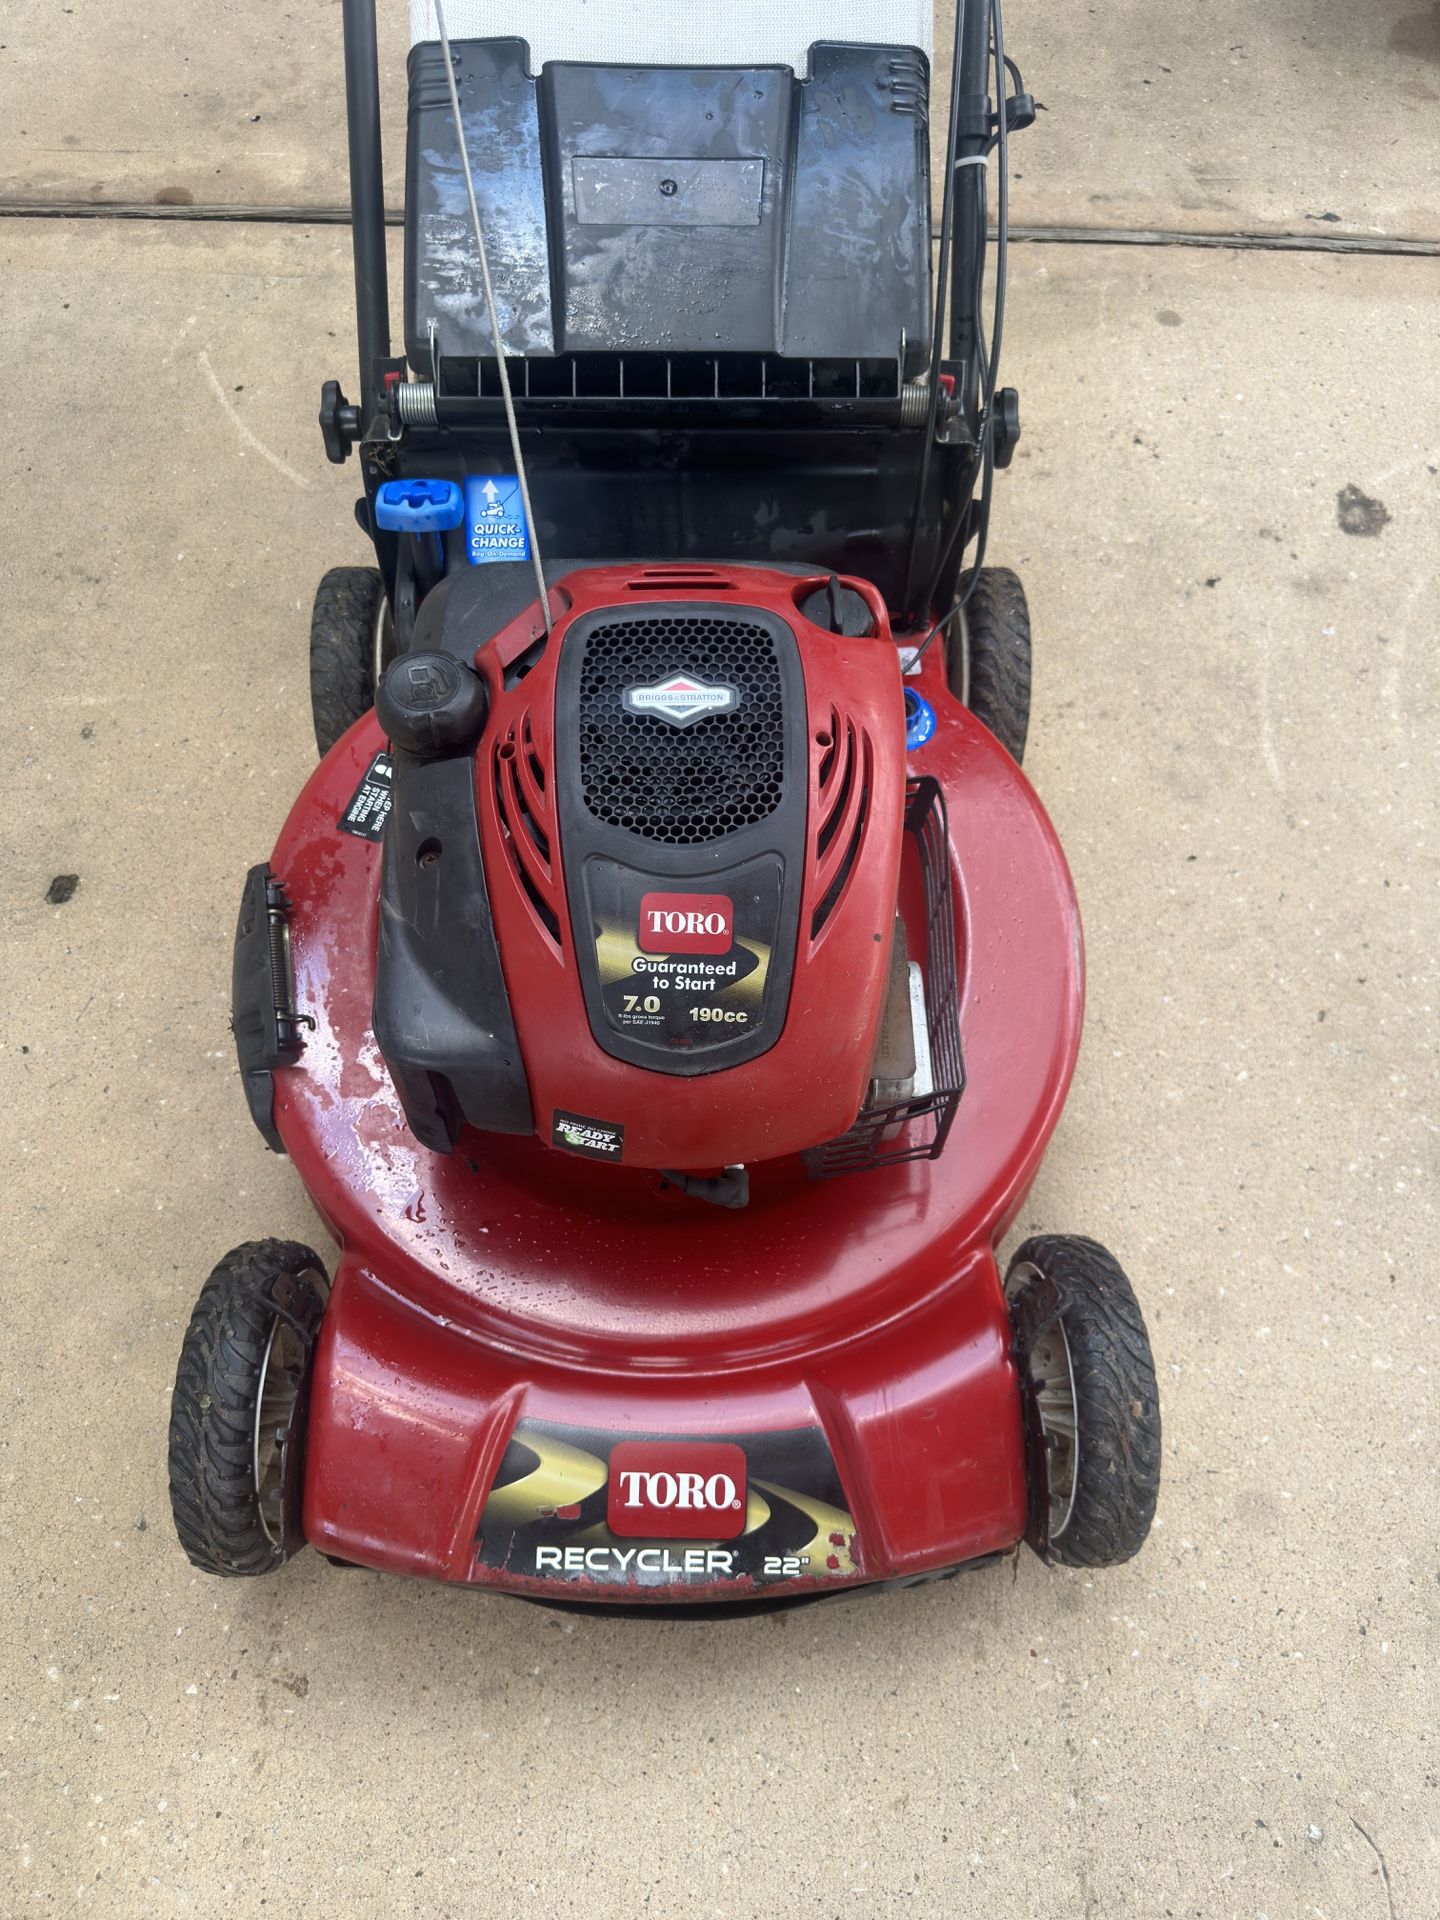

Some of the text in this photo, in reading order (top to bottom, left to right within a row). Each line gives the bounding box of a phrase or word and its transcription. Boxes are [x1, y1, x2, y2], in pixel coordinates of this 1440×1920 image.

[474, 524, 521, 535] QUICK-
[471, 537, 525, 548] CHANGE
[362, 784, 372, 796] AT
[347, 795, 367, 822] ENGINE
[356, 787, 380, 823] STARTING
[372, 790, 389, 812] WHEN
[371, 811, 388, 832] HERE
[632, 958, 736, 975] Guaranteed
[652, 976, 716, 990] to Start
[623, 995, 661, 1013] 7.0
[689, 1007, 748, 1023] 190cc
[555, 1122, 616, 1143] READY
[566, 1134, 620, 1152] START
[763, 1556, 811, 1575] 22"
